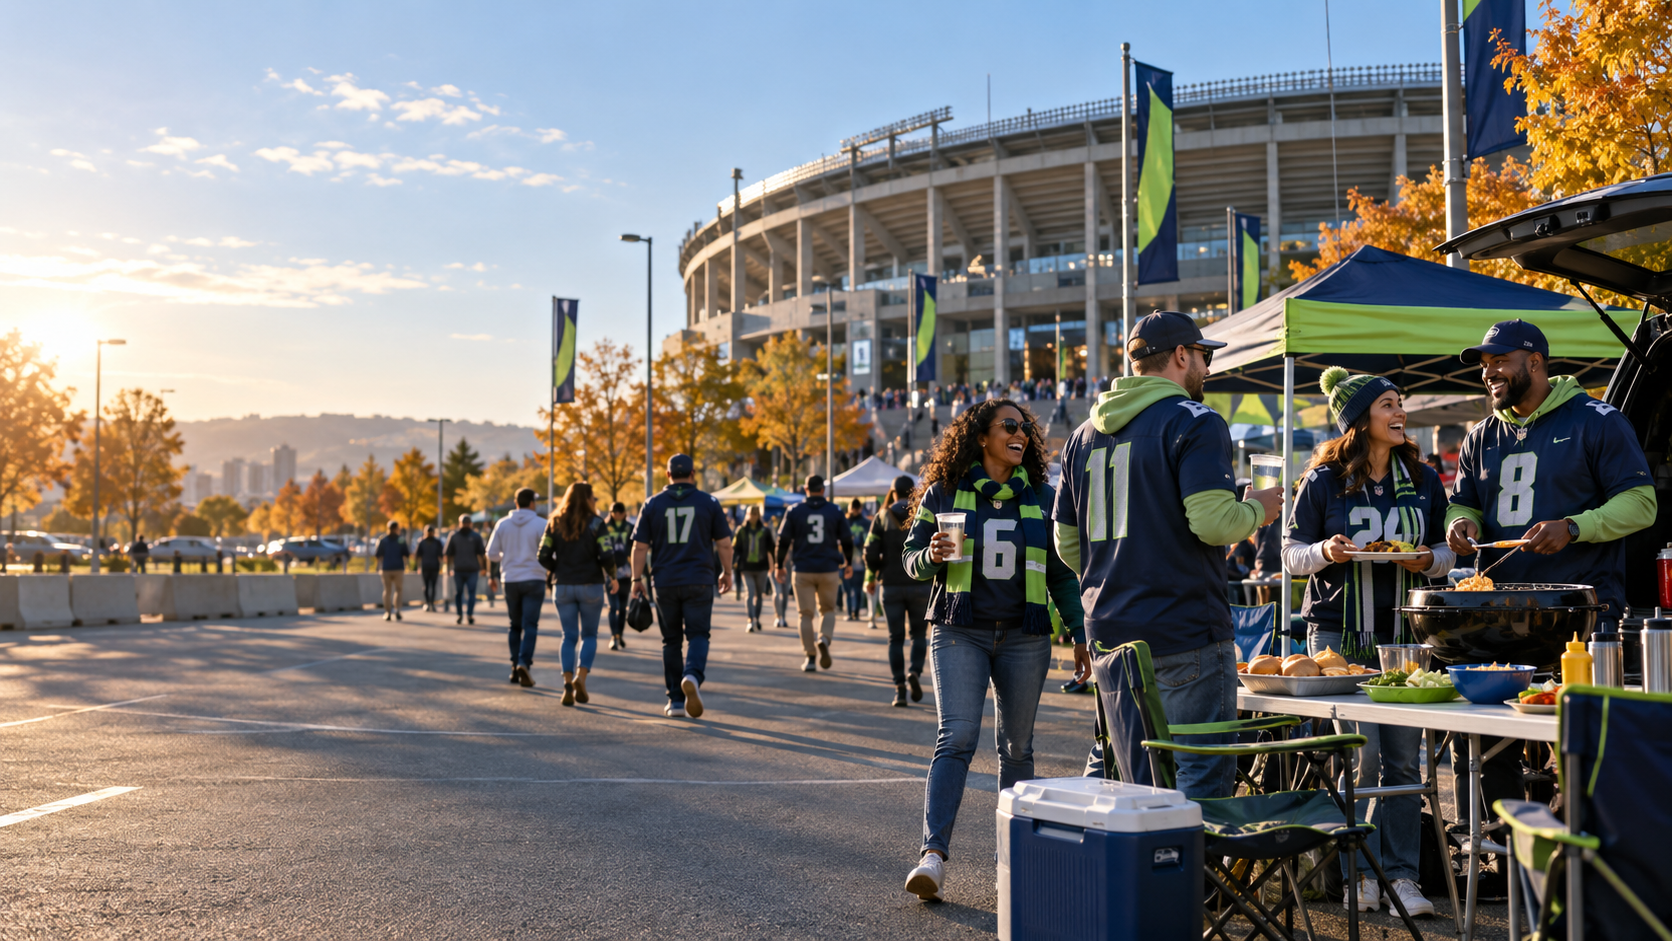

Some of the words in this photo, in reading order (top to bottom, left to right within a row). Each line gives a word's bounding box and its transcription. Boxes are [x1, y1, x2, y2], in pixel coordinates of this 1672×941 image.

[1085, 441, 1132, 542] 11
[1497, 451, 1539, 527] 8
[665, 506, 695, 544] 17
[807, 514, 825, 544] 3
[982, 518, 1018, 580] 6
